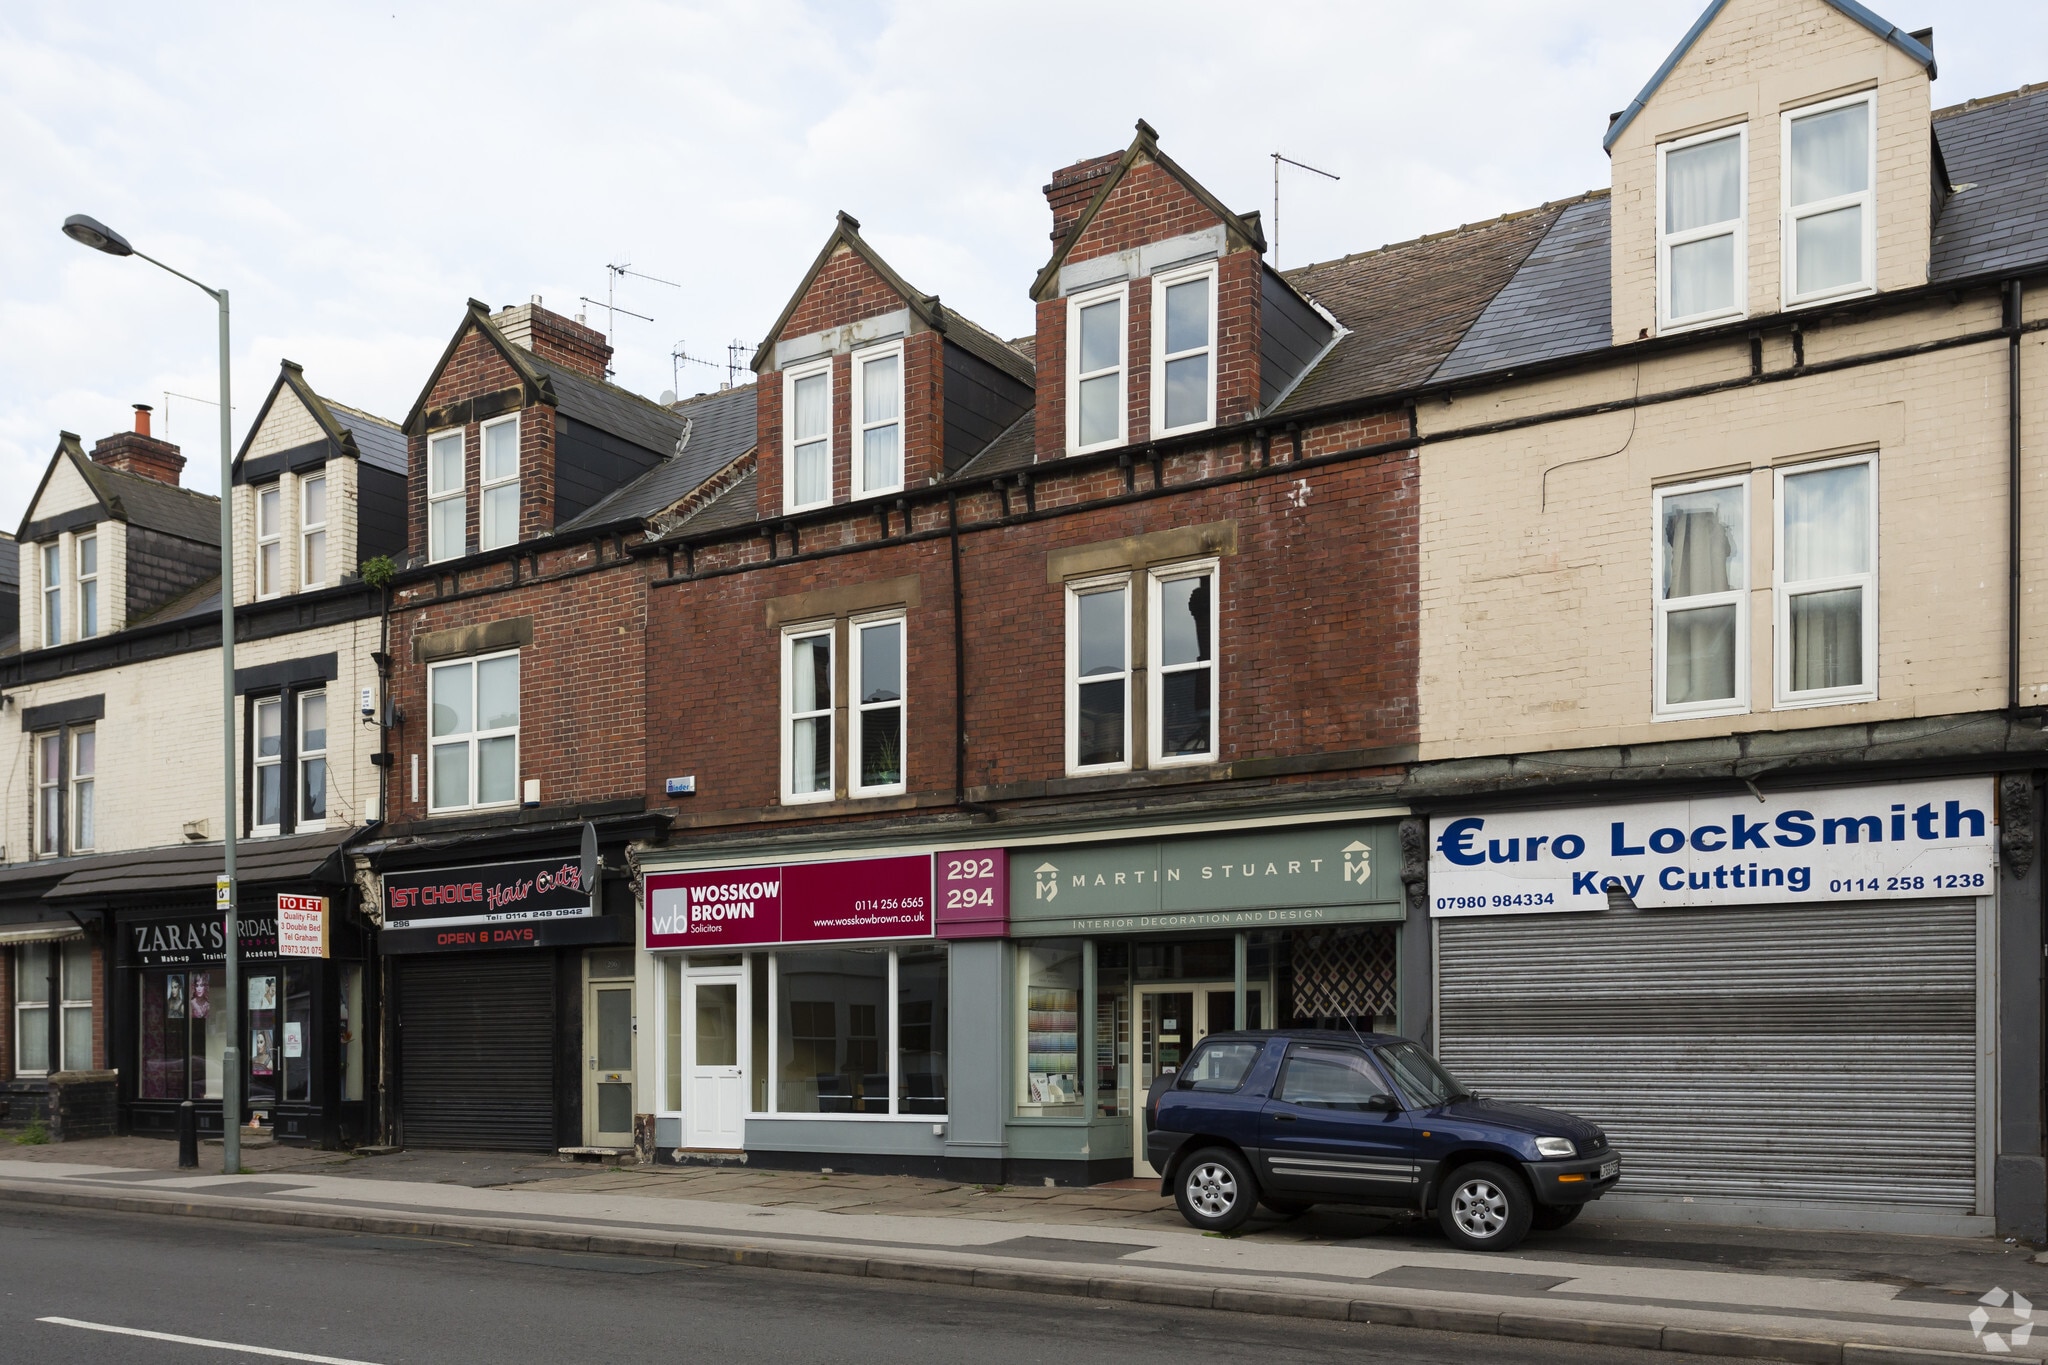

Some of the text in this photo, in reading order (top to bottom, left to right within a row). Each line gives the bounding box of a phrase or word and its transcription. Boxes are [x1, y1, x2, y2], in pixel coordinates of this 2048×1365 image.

[1609, 800, 1987, 858] LockSmith
[947, 858, 995, 881] 292
[1072, 858, 1324, 888] MARTIN STUART
[389, 863, 582, 911] 1ST CHOICE Hair Cutz
[1572, 863, 1811, 898] Key Cutting
[1829, 873, 1985, 893] 0114 258 1238
[690, 881, 780, 903] WOSSKOW
[946, 887, 994, 909] 294
[281, 897, 321, 911] TO LET
[855, 897, 924, 911] 0114 256 6565
[1436, 893, 1555, 911] 07980 984334
[283, 912, 318, 922] Quality Flat
[555, 908, 583, 916] 0942
[652, 904, 687, 934] wb
[691, 902, 755, 922] BROWN
[813, 912, 925, 928] www.wosskowbrown.co.uk
[286, 923, 307, 931] Double
[308, 924, 321, 932] Bed
[393, 920, 410, 928] 296
[690, 923, 723, 934] Solicitors
[135, 918, 276, 952] ZARA'S RIDAL
[284, 932, 318, 942] Tel Graham
[437, 928, 534, 945] OPEN 6 DAYS
[161, 955, 190, 963] Make-up
[245, 950, 278, 959] Academy
[281, 945, 322, 955] 07973 321 075
